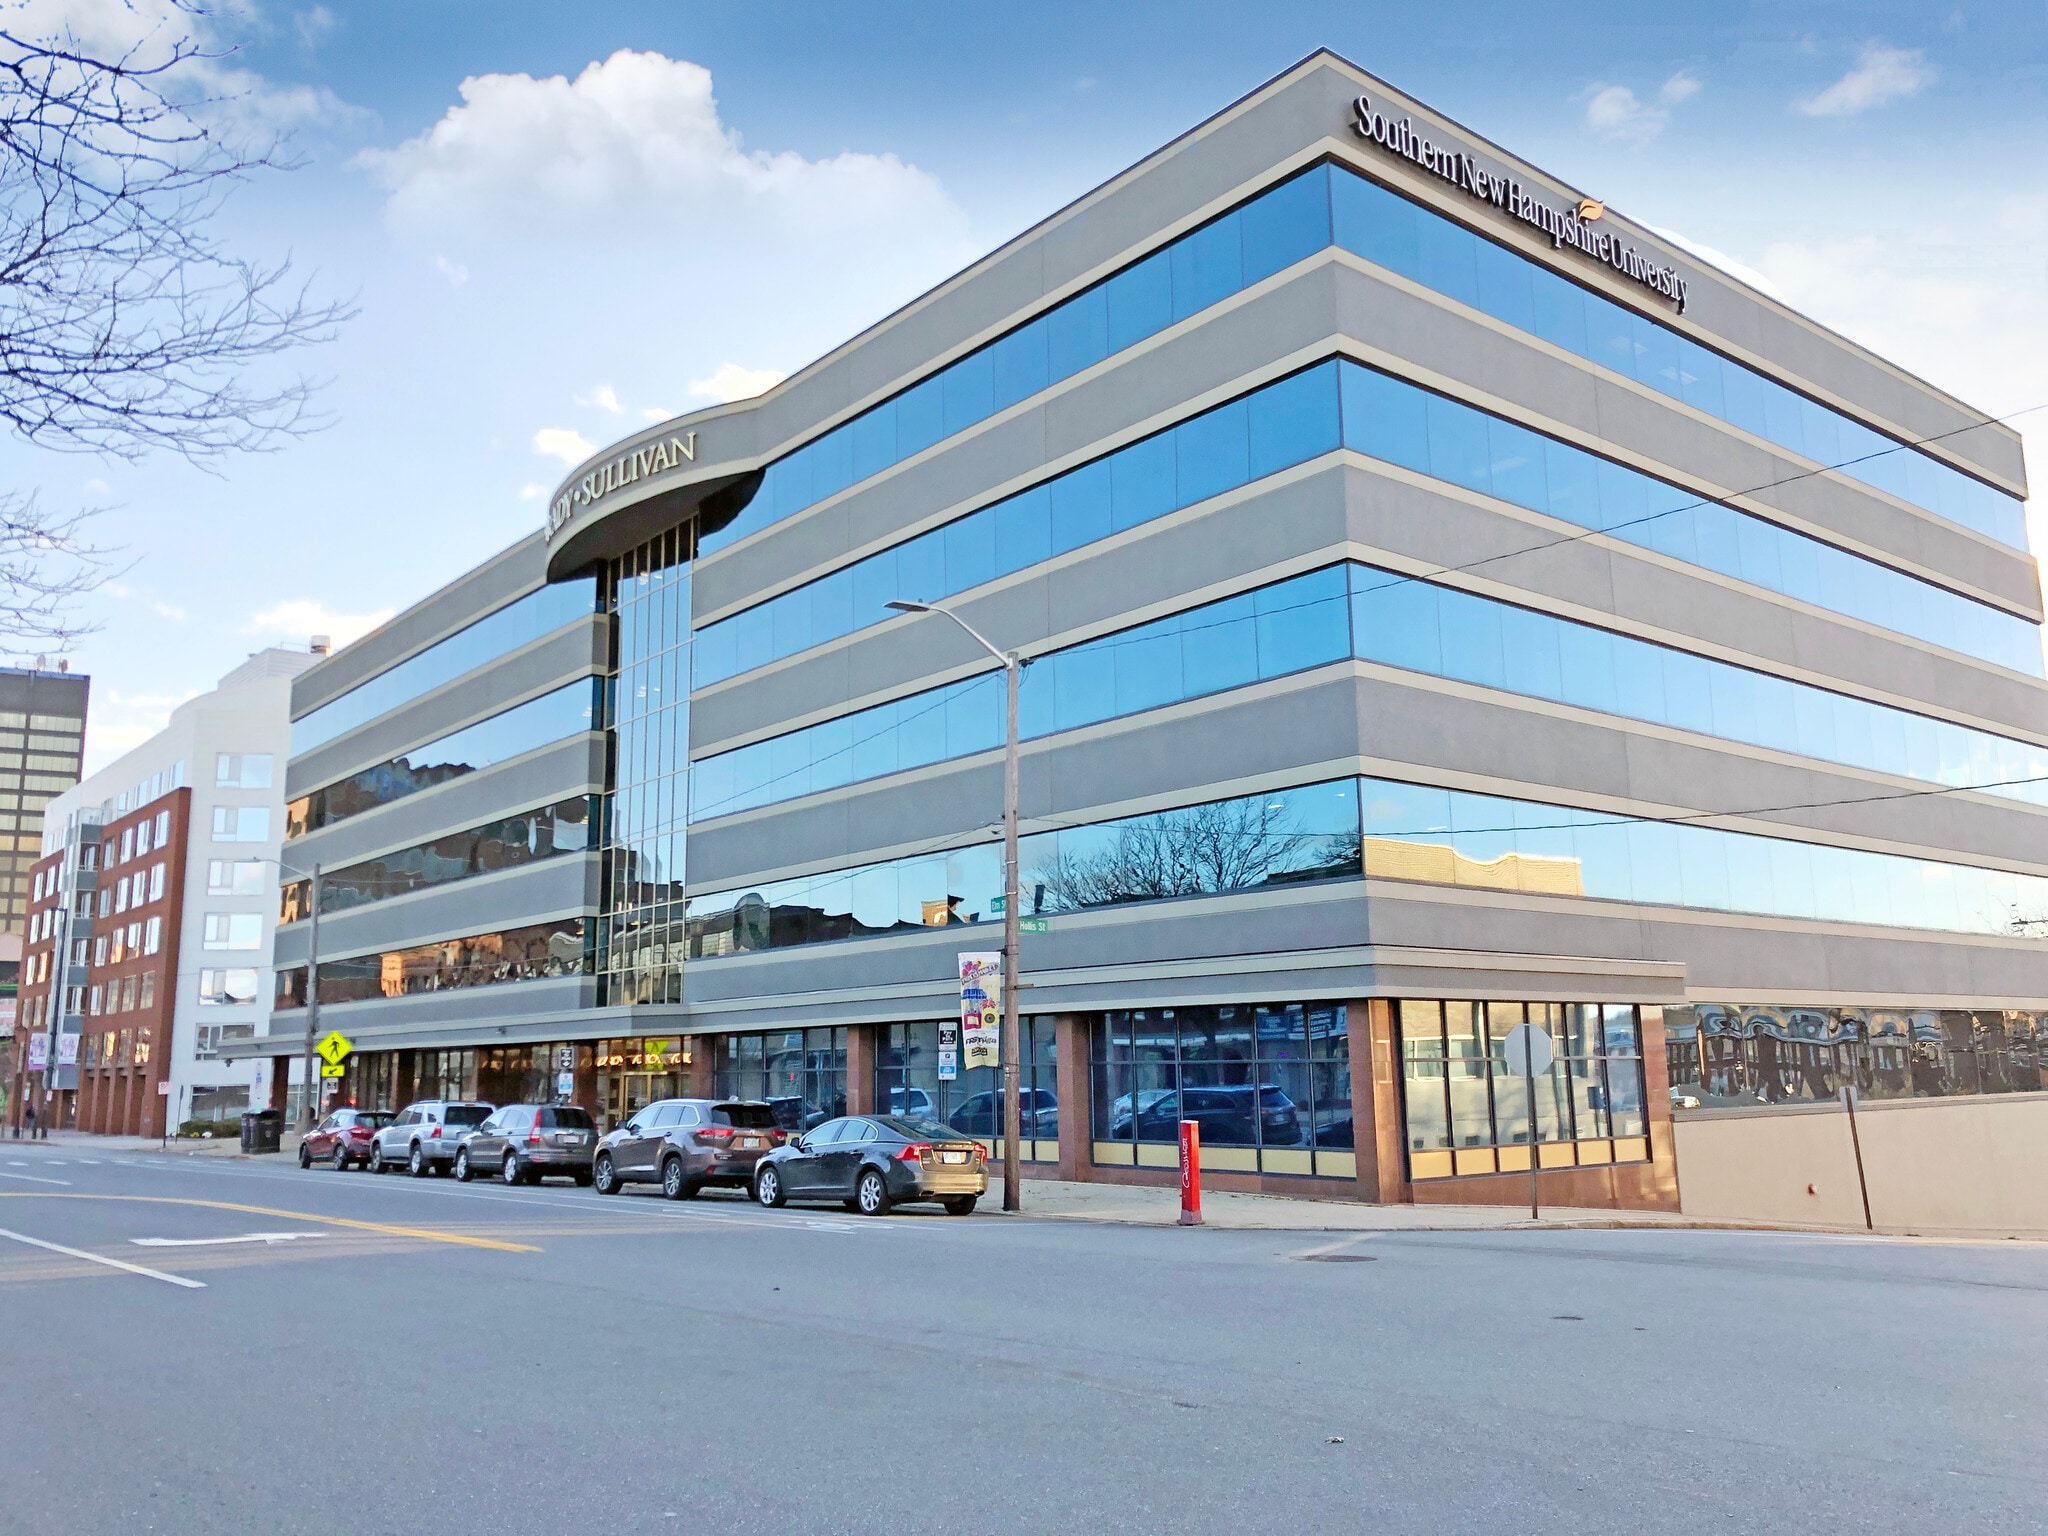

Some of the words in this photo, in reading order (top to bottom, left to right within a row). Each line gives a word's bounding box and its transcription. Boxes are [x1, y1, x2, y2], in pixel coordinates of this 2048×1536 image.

[1354, 94, 1458, 184] Southern
[1460, 152, 1507, 207] New
[1508, 182, 1609, 263] Hampshire
[1608, 233, 1689, 313] University
[581, 431, 697, 506] SULLIVAN
[1019, 920, 1037, 931] Hollis
[1038, 922, 1046, 932] St
